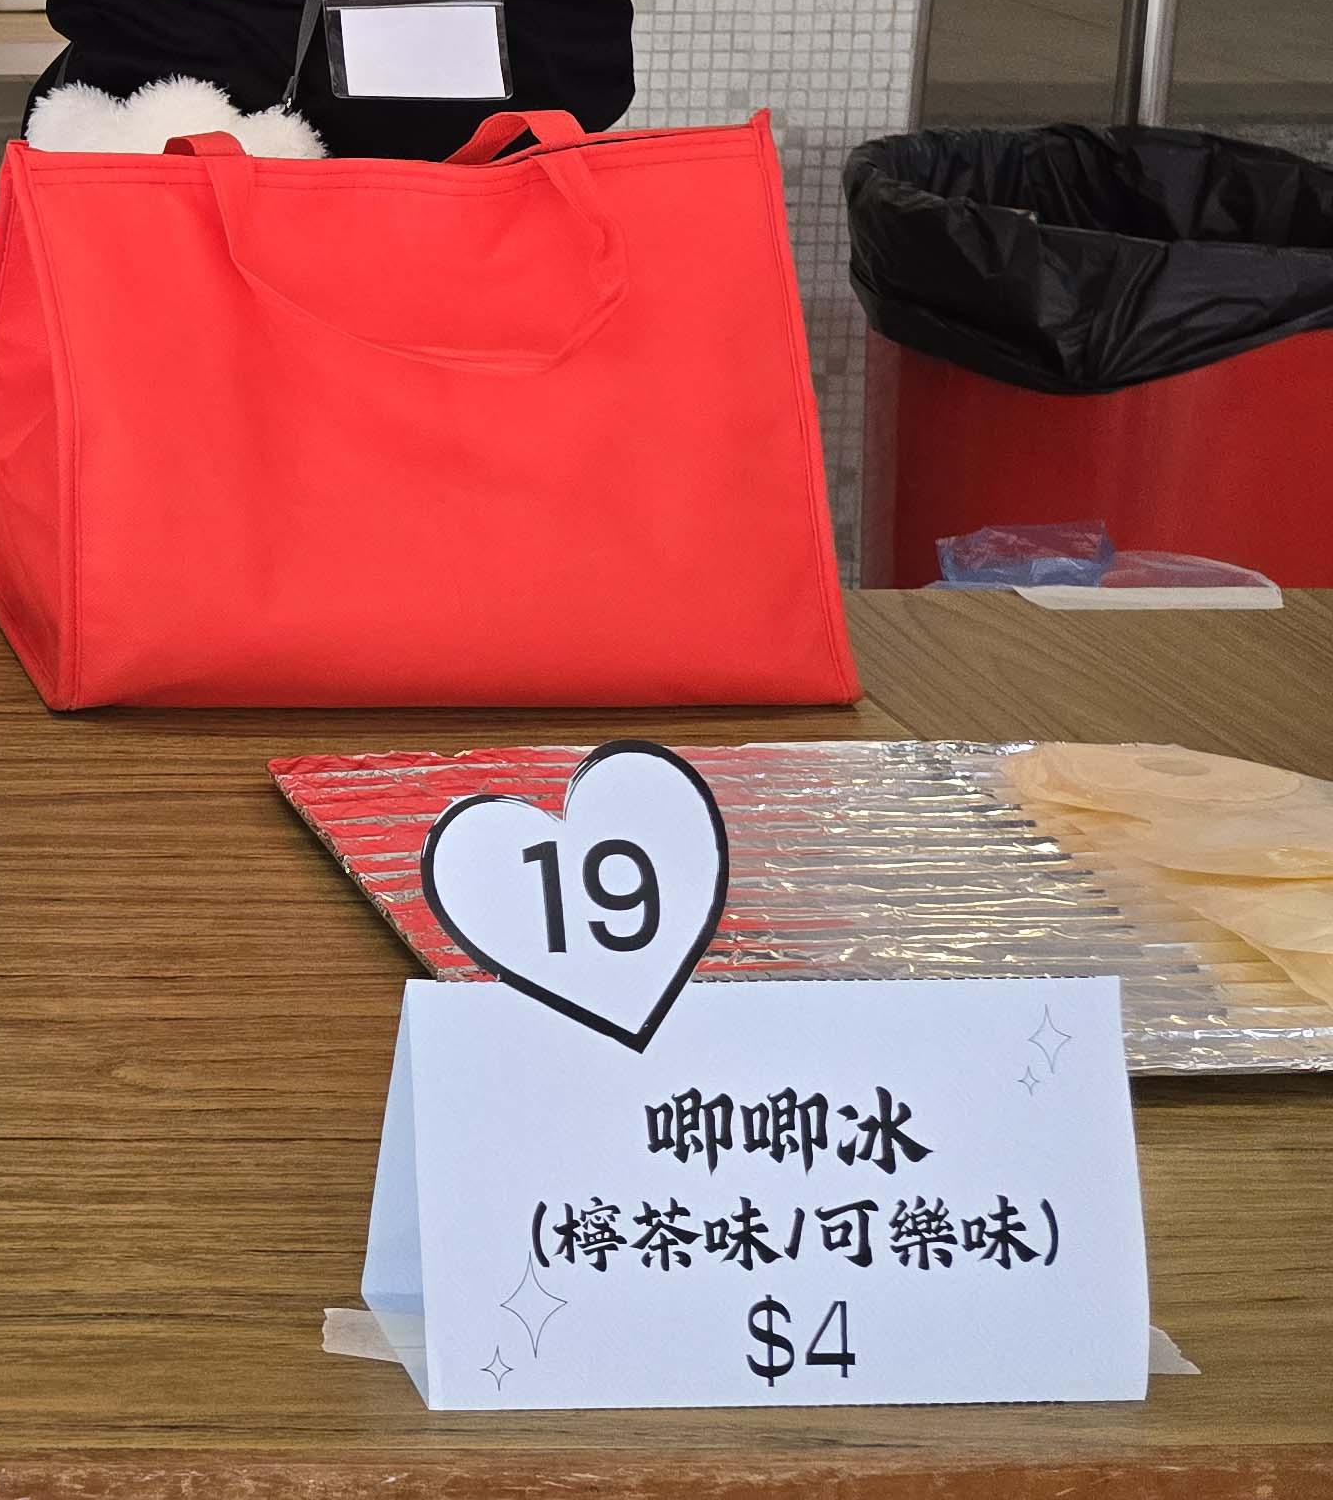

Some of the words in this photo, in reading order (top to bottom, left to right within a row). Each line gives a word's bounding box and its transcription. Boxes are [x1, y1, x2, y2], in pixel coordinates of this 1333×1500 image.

[521, 838, 661, 954] 19
[644, 1086, 934, 1176] 唧唧冰
[531, 1196, 1061, 1274] (檸茶味/可樂味)
[745, 1294, 857, 1388] $4
